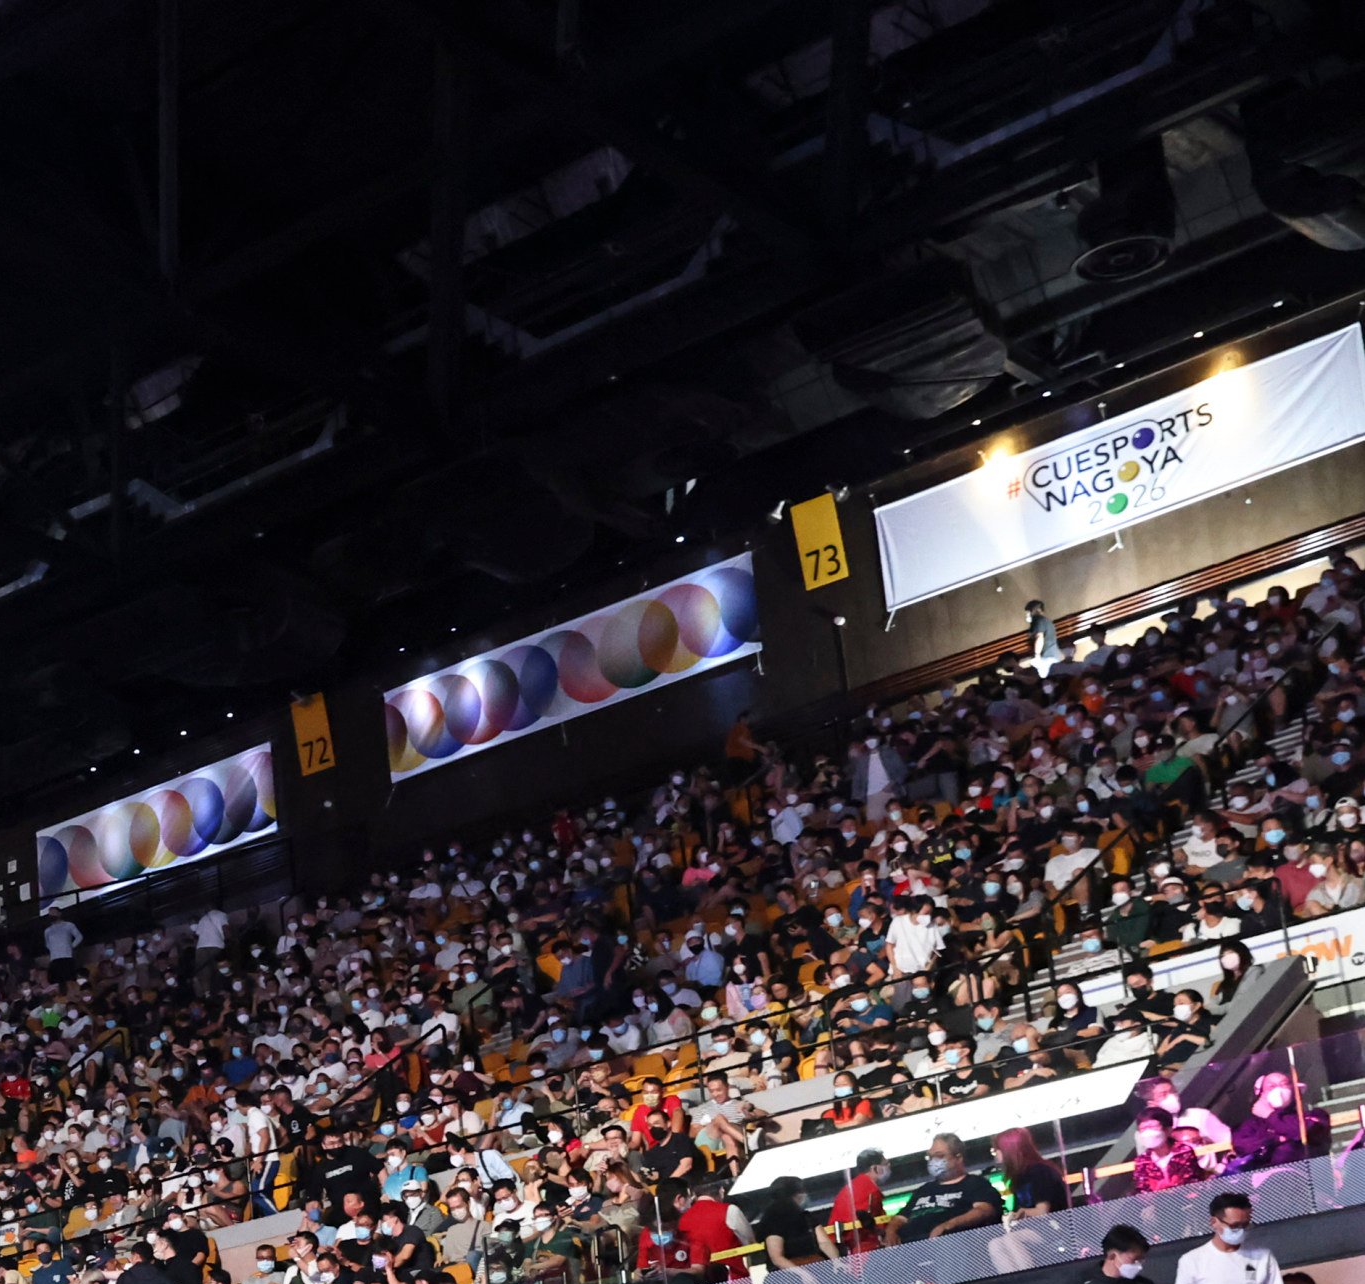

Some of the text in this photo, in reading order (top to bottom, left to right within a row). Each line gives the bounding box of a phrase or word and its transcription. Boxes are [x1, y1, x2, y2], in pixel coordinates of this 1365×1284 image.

[1045, 445, 1183, 513] NAGOYA
[1089, 480, 1167, 525] 2026
[806, 544, 841, 581] 73
[301, 736, 330, 766] 72
